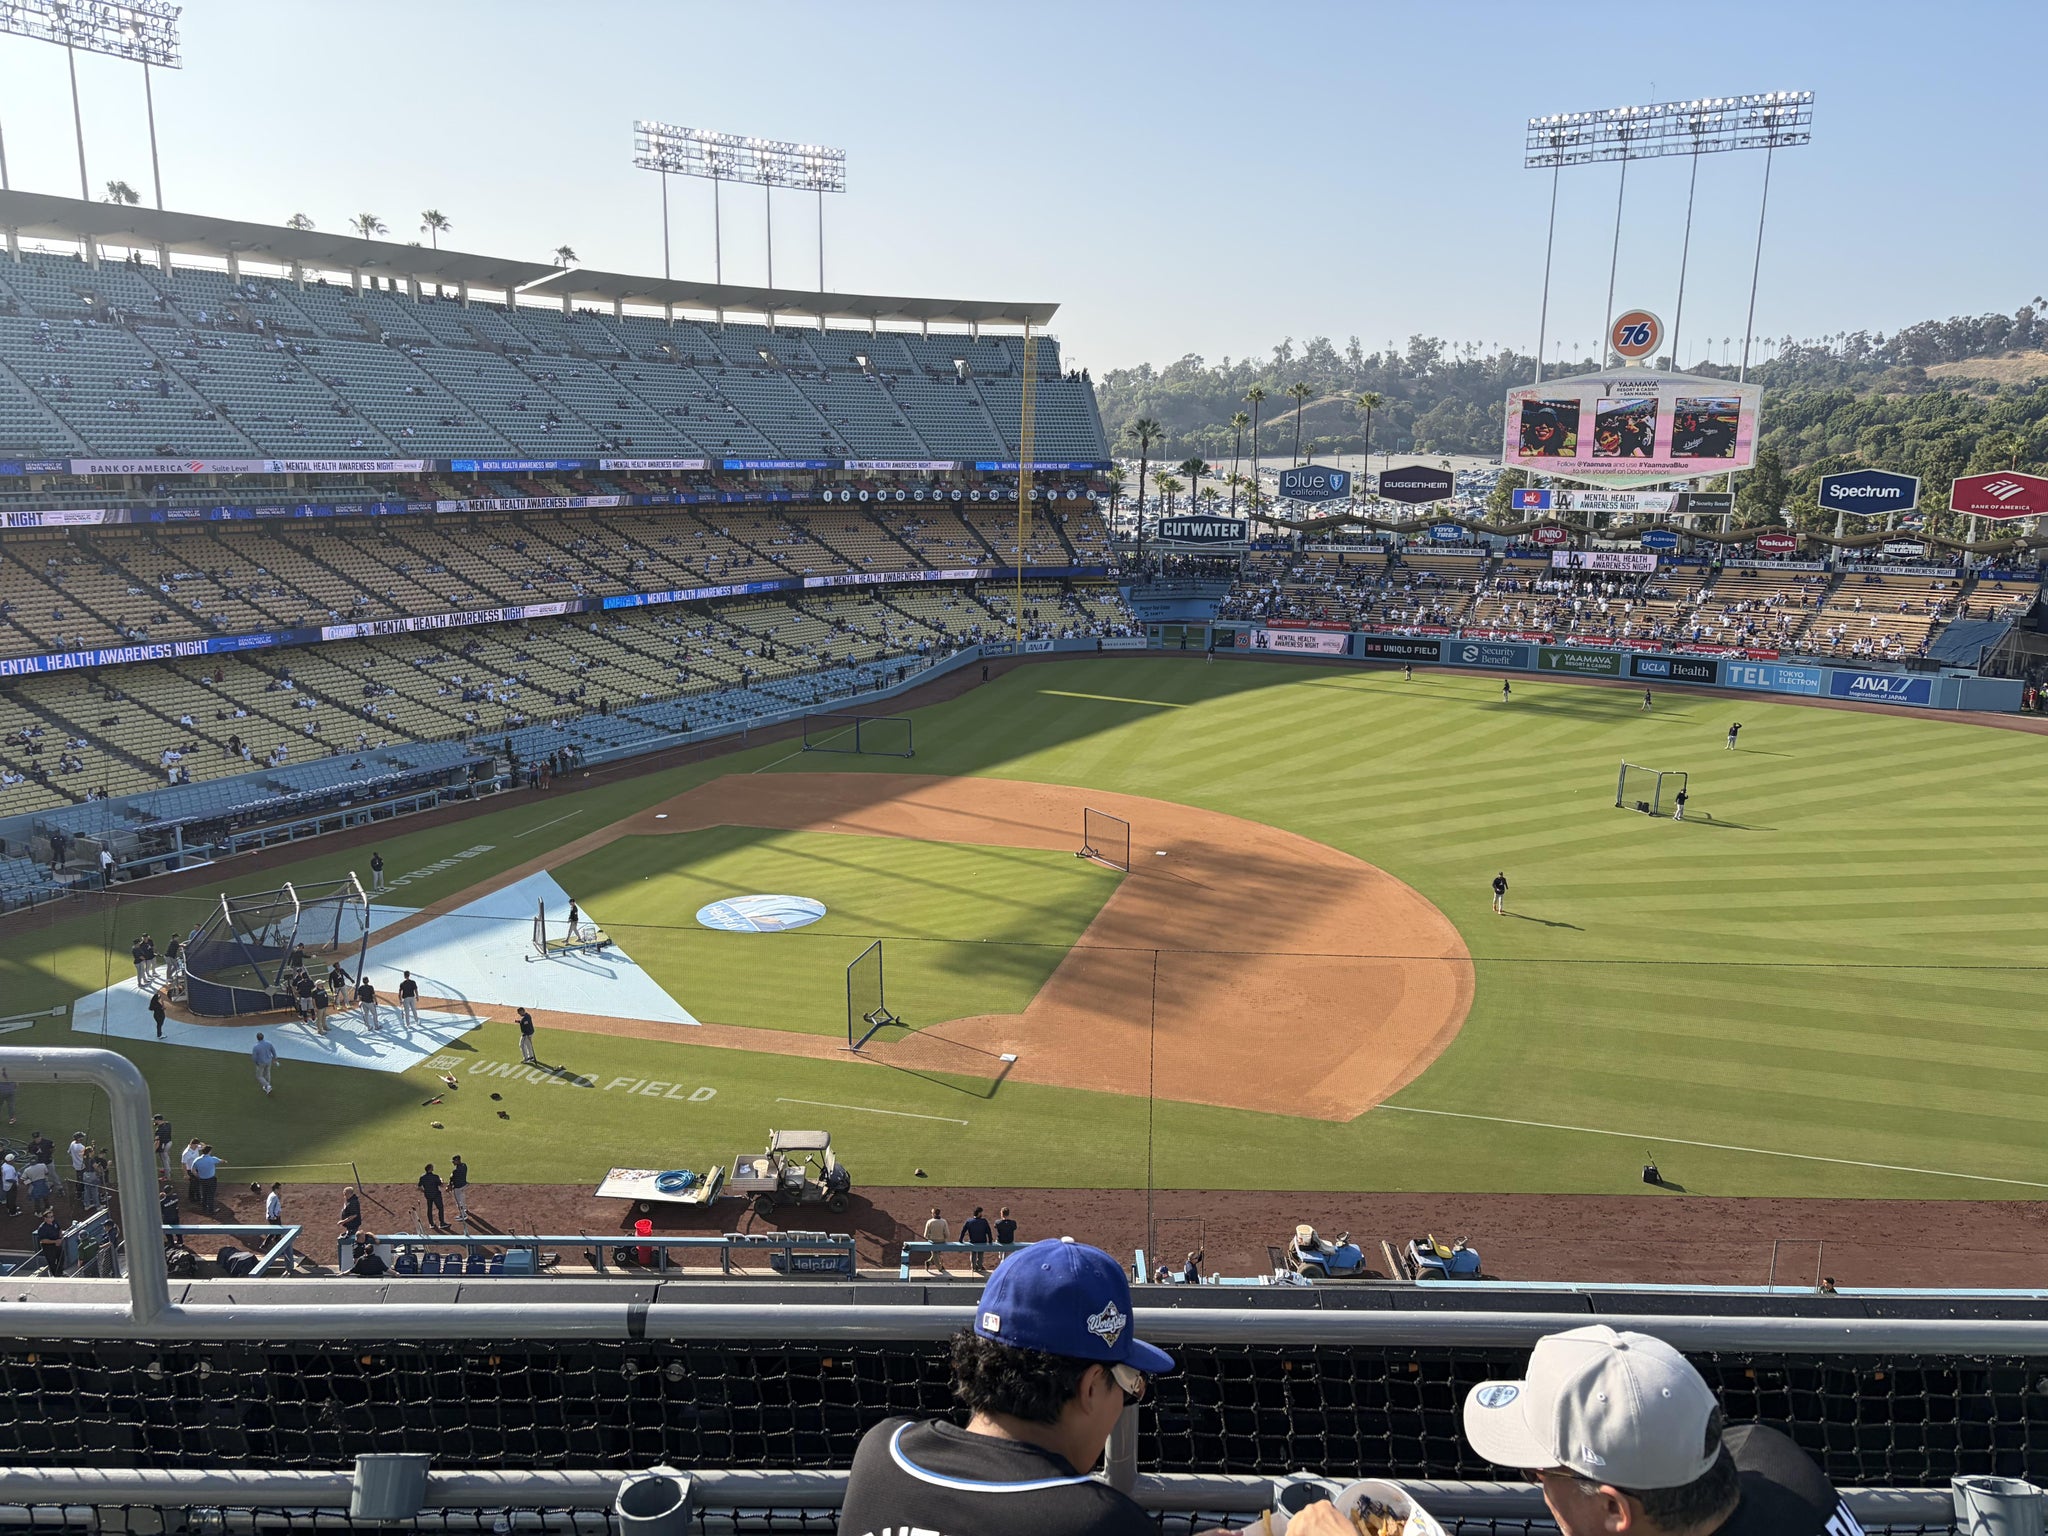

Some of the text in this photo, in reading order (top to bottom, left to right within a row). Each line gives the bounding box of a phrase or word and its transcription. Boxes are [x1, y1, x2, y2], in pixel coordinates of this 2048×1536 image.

[1618, 321, 1651, 347] 76
[90, 465, 120, 473] BANK
[137, 464, 183, 473] AMERICA
[212, 464, 249, 472] Suite Level
[286, 461, 394, 471] MENTAL HEALTH AWARENESS NIGHT
[482, 461, 500, 469] MENTAL
[501, 461, 519, 469] HEALTH
[519, 461, 544, 469] AWARENESS
[1639, 461, 1689, 469] #YaamavaBlue
[1285, 472, 1325, 489] blue
[1384, 481, 1448, 489] GUGGENHEIM
[1290, 488, 1329, 496] california
[1584, 493, 1635, 502] MENTAL HEALTH
[1829, 484, 1901, 500] Spectrum
[469, 500, 498, 511] MENTAL
[500, 499, 526, 510] HEALTH
[526, 498, 567, 509] AWARENESS
[568, 498, 588, 507] NIGHT
[1580, 501, 1618, 510] AWARENESS
[1619, 502, 1640, 510] NIGHT
[7, 513, 43, 526] NIGHT
[1163, 522, 1240, 538] CUTWATER
[1538, 529, 1562, 539] JINRO
[1759, 539, 1795, 547] Yakult
[1596, 553, 1648, 562] MENTAL HEALTH
[1591, 562, 1652, 571] AWARENESS NIGHT
[833, 570, 942, 585] MENTAL HEALTH AWARENESS NIGHT
[647, 592, 672, 604] MENTAL
[673, 590, 696, 602] HEALTH
[696, 586, 731, 599] AWARENESS
[731, 584, 749, 595] NIGHT
[373, 619, 411, 635] MENTAL
[413, 615, 446, 630] HEALTH
[449, 609, 500, 626] AWARENESS
[501, 606, 526, 621] NIGHT
[1256, 630, 1268, 648] LA
[1277, 634, 1316, 643] MENTAL HEALTH
[1027, 642, 1045, 651] ANA
[1383, 644, 1412, 654] UNIQLO
[1414, 646, 1438, 655] FIELD
[1481, 645, 1516, 657] Security
[0, 639, 209, 676] ENTAL HEALTH AWARENESS NIGHT
[1481, 655, 1512, 665] Benefit
[1641, 662, 1709, 678] UCLA Health
[1778, 669, 1804, 678] TOKYO
[1729, 666, 1770, 686] TEL
[1778, 677, 1817, 687] ELECTRON
[1850, 676, 1889, 692] ANA
[1849, 690, 1880, 699] Inspiration
[1887, 693, 1908, 702] JAPAN
[388, 858, 463, 885] UNIQLO
[467, 1059, 600, 1088] UNIQLO
[602, 1076, 718, 1102] FIELD
